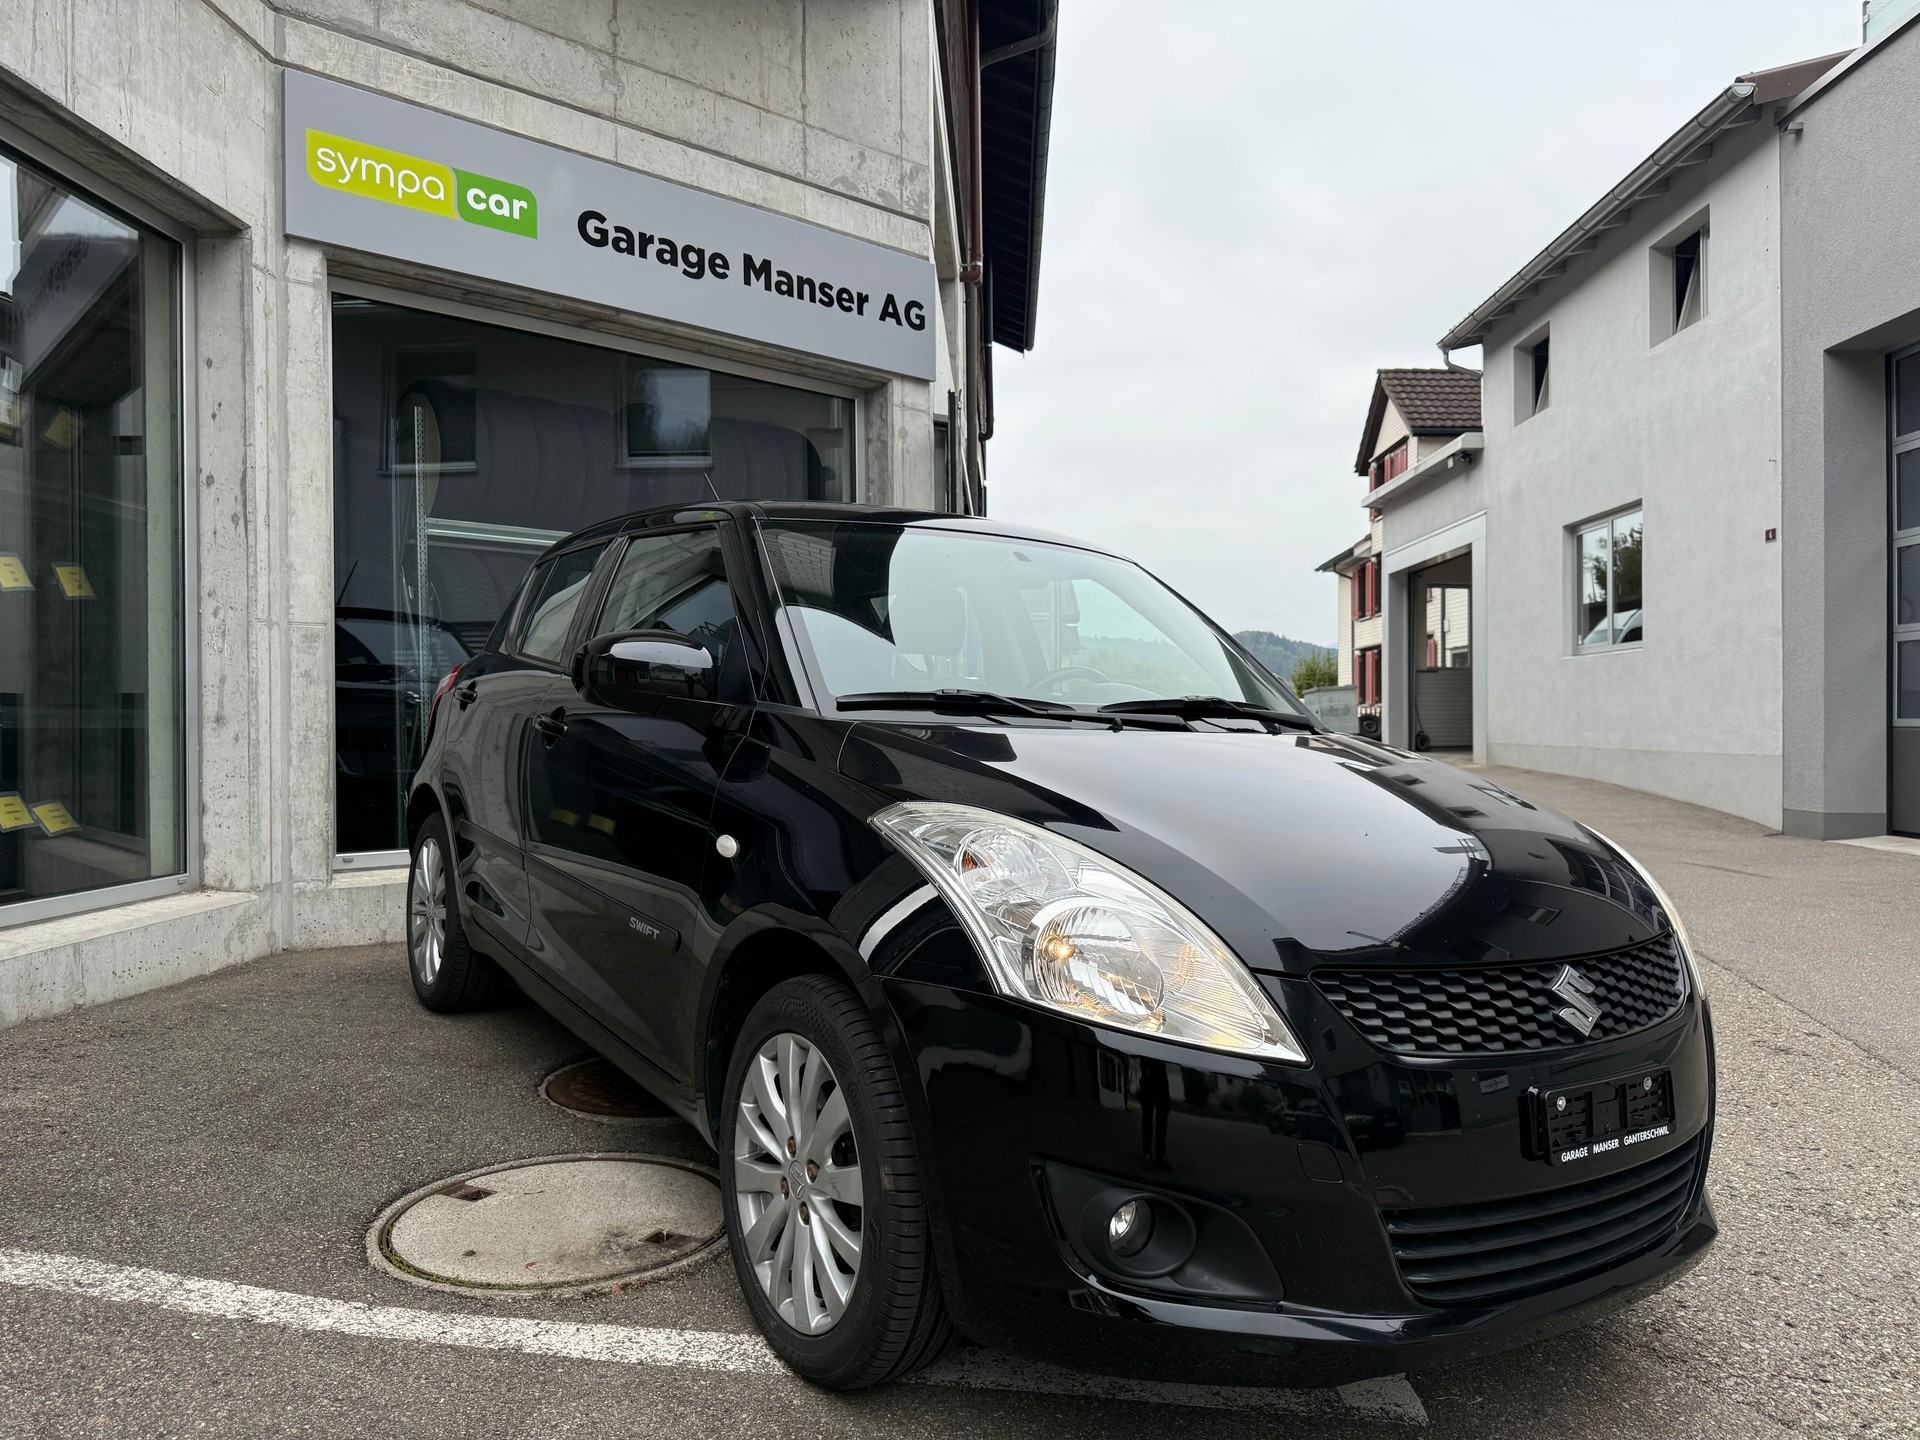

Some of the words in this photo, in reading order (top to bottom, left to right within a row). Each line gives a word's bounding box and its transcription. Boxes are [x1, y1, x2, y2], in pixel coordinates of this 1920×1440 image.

[316, 147, 445, 200] sympa
[466, 187, 528, 219] car
[577, 210, 730, 280] Garage
[742, 253, 869, 316] Manser
[879, 293, 926, 331] AG
[629, 916, 660, 940] SWIFT
[1561, 1146, 1588, 1163] GARAGE
[1593, 1138, 1620, 1155] MANSER
[1623, 1125, 1670, 1146] GANTERSCHWIL
